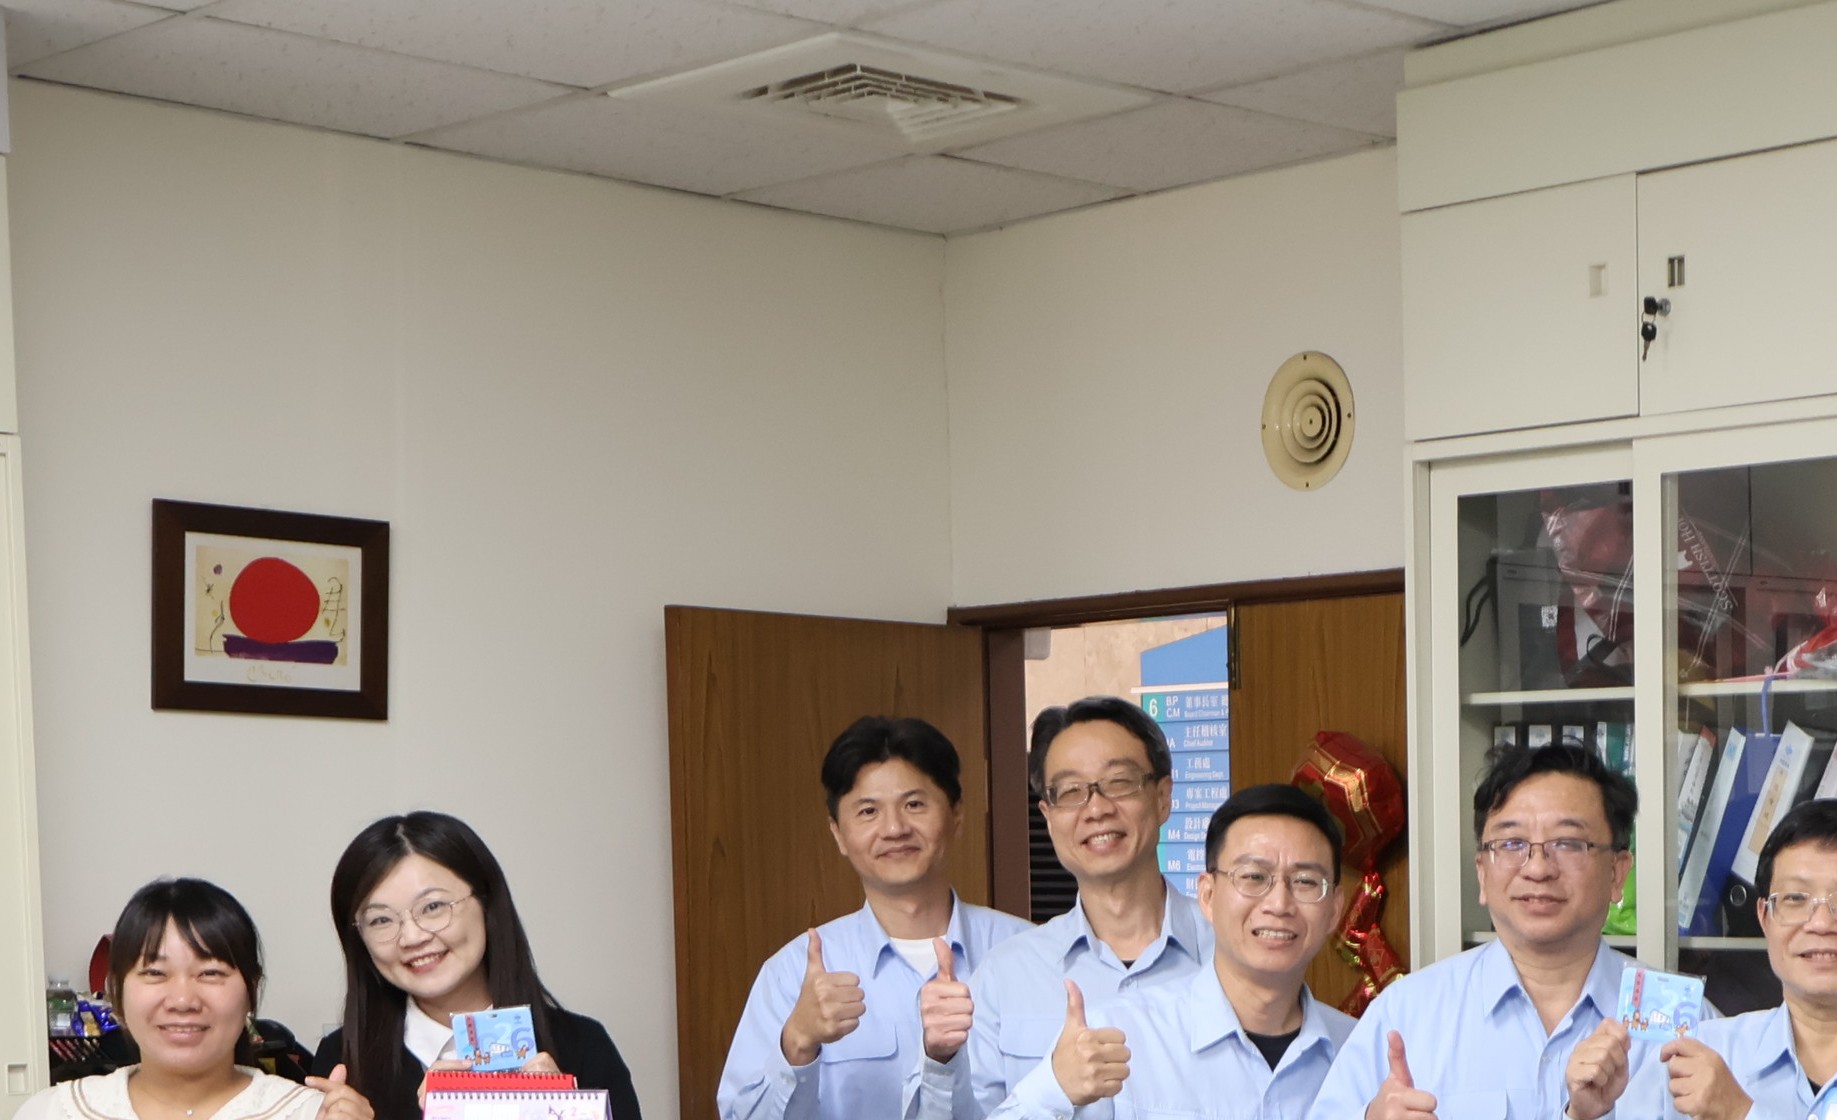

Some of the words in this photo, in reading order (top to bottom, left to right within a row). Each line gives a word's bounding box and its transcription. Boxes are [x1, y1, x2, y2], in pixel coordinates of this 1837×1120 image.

[1149, 698, 1158, 717] 6
[1168, 829, 1180, 839] M4
[1168, 860, 1180, 870] M6
